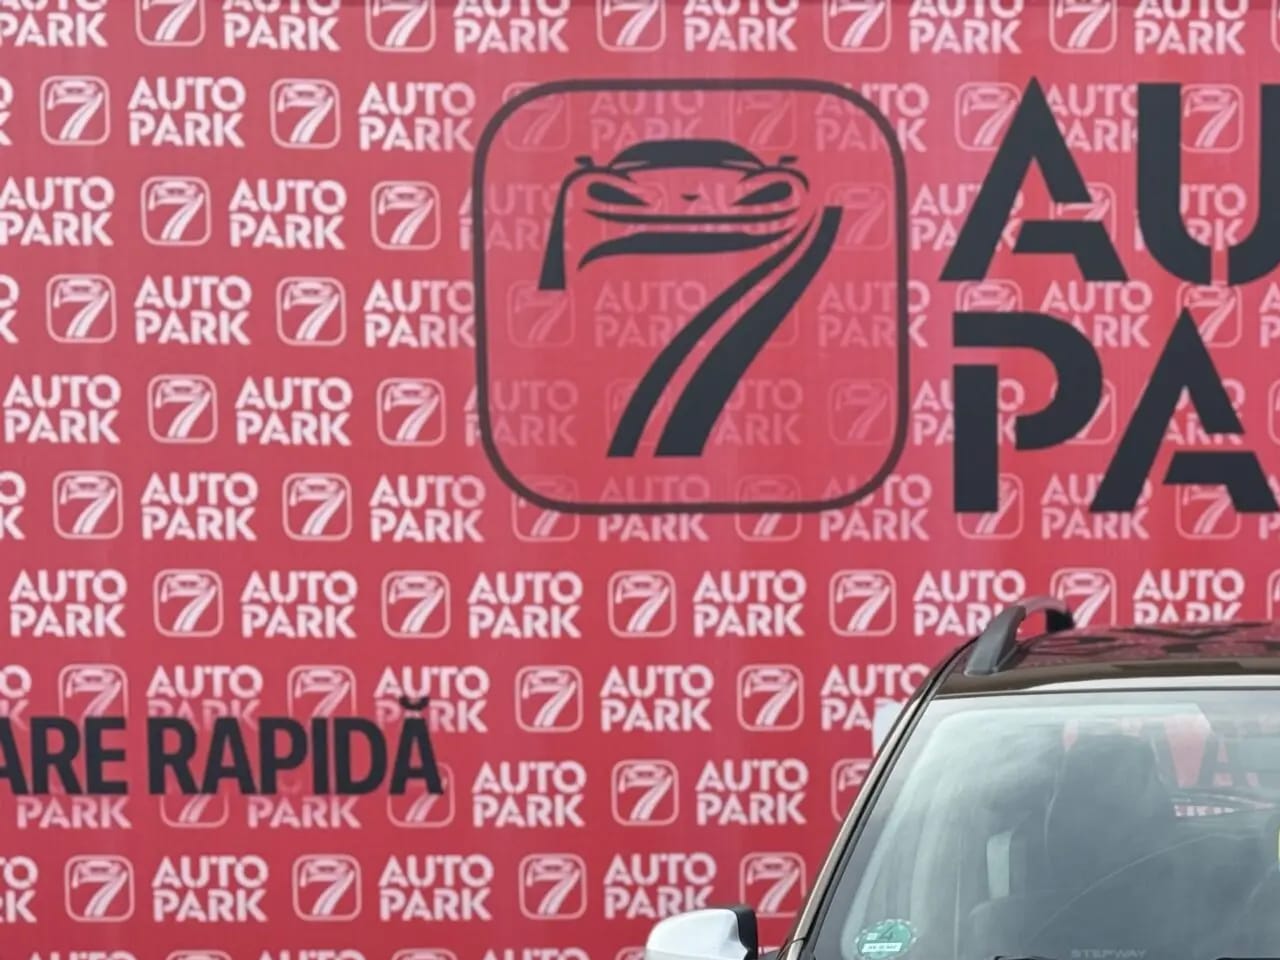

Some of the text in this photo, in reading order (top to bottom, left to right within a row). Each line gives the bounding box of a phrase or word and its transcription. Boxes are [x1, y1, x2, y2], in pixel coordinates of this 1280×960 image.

[225, 12, 339, 51] PARK
[455, 17, 567, 53] PARK
[685, 17, 796, 51] PARK
[910, 18, 1020, 53] PARK
[1135, 19, 1244, 54] PARK
[128, 77, 245, 111] AUTO
[359, 82, 475, 115] AUTO
[130, 112, 244, 147] PARK
[360, 116, 472, 150] PARK
[229, 179, 346, 212] AUTO
[230, 212, 344, 249] PARK
[135, 276, 252, 309] AUTO
[364, 279, 473, 312] AUTO
[136, 309, 250, 345] PARK
[365, 312, 475, 347] PARK
[3, 375, 121, 408] AUTO
[235, 377, 352, 410] AUTO
[5, 409, 119, 443] PARK
[237, 410, 350, 446] PARK
[141, 472, 258, 506] AUTO
[370, 475, 485, 507] AUTO
[142, 506, 256, 540] PARK
[371, 507, 483, 542] PARK
[9, 569, 127, 603] AUTO
[241, 571, 357, 603] AUTO
[468, 572, 582, 604] AUTO
[693, 570, 806, 602] AUTO
[11, 603, 125, 637] PARK
[242, 603, 355, 638] PARK
[469, 604, 580, 638] PARK
[694, 602, 803, 637] PARK
[374, 666, 489, 699] AUTO
[600, 665, 714, 697] AUTO
[377, 700, 487, 732] PARK
[601, 697, 711, 731] PARK
[148, 696, 443, 795] RAPIDĂ
[472, 761, 586, 793] AUTO
[696, 759, 808, 791] AUTO
[473, 793, 584, 827] PARK
[697, 791, 805, 825] PARK
[152, 855, 268, 888] AUTO
[379, 854, 494, 887] AUTO
[605, 853, 716, 885] AUTO
[154, 888, 266, 921] PARK
[380, 887, 491, 920] PARK
[605, 885, 714, 920] PARK
